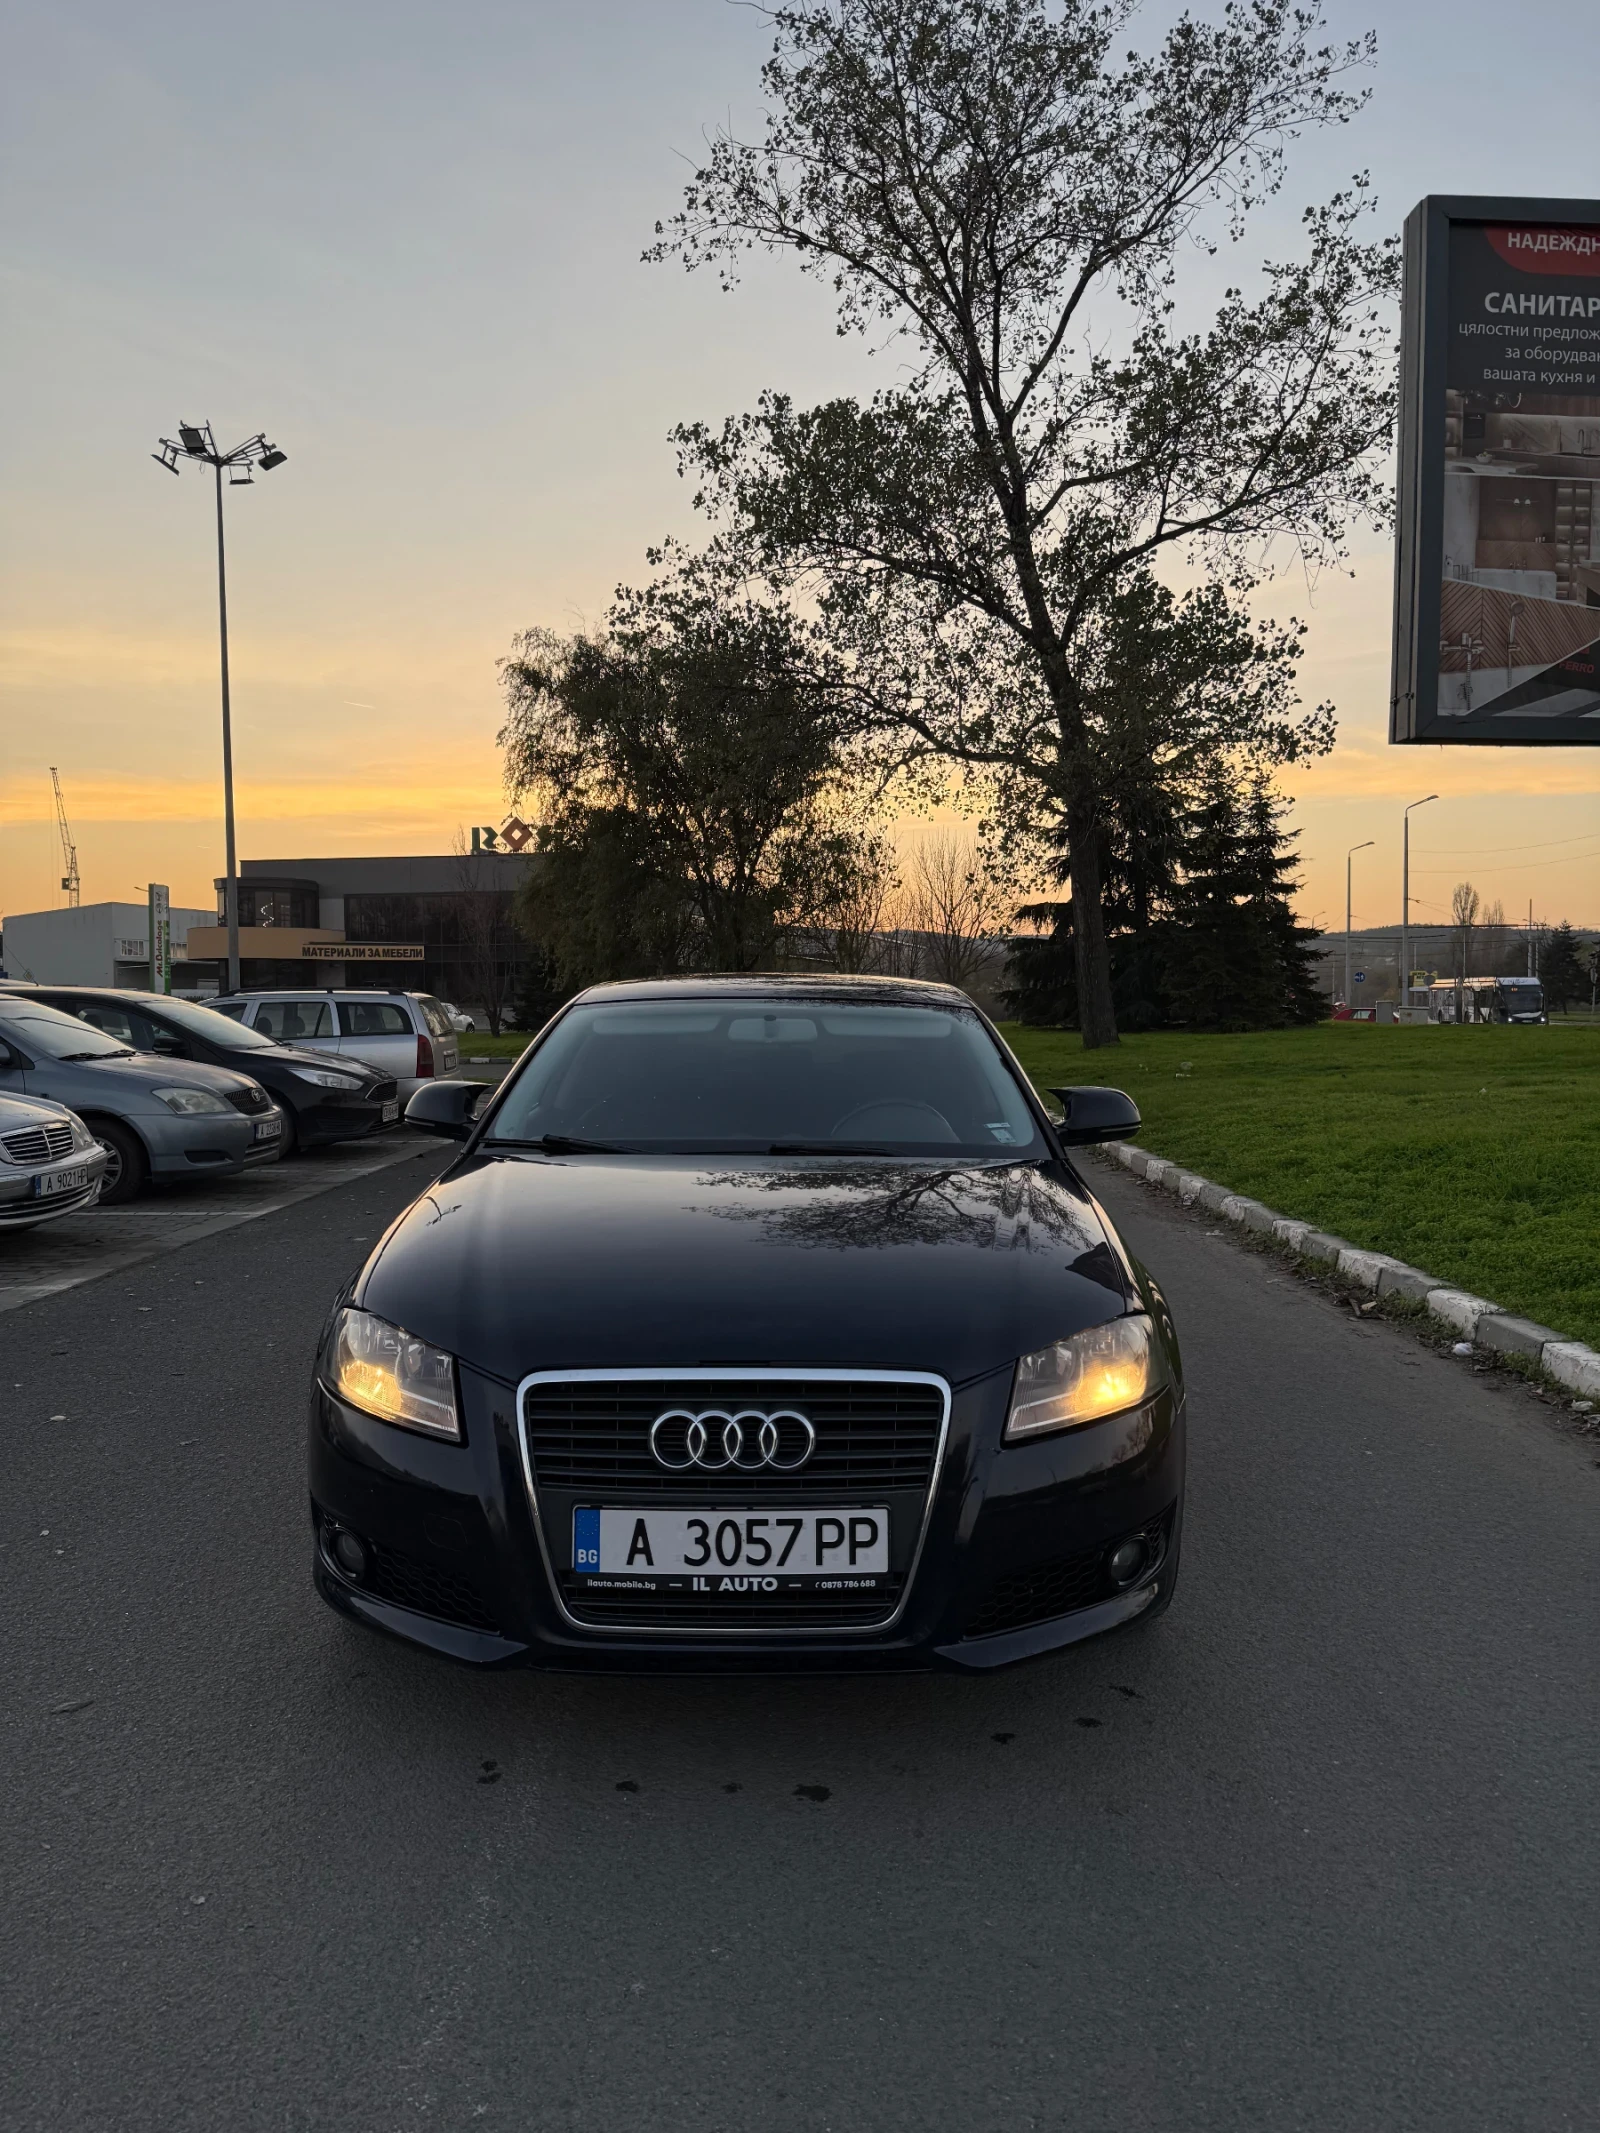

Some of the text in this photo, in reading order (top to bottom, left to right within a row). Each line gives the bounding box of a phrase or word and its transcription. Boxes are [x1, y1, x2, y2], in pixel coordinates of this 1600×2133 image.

[1484, 291, 1600, 318] САНИТАР
[1458, 322, 1529, 337] цялостни
[1504, 347, 1520, 359] за
[1483, 368, 1596, 385] вашата кухня и
[1559, 660, 1595, 674] FERRO
[302, 946, 423, 958] МАТЕРИАЛИ ЗА МЕБЕЛИ
[577, 1549, 598, 1564] BG
[625, 1518, 655, 1567] A
[587, 1577, 876, 1592] ilauto.mobile.bg IL AUTO 0878 786 688
